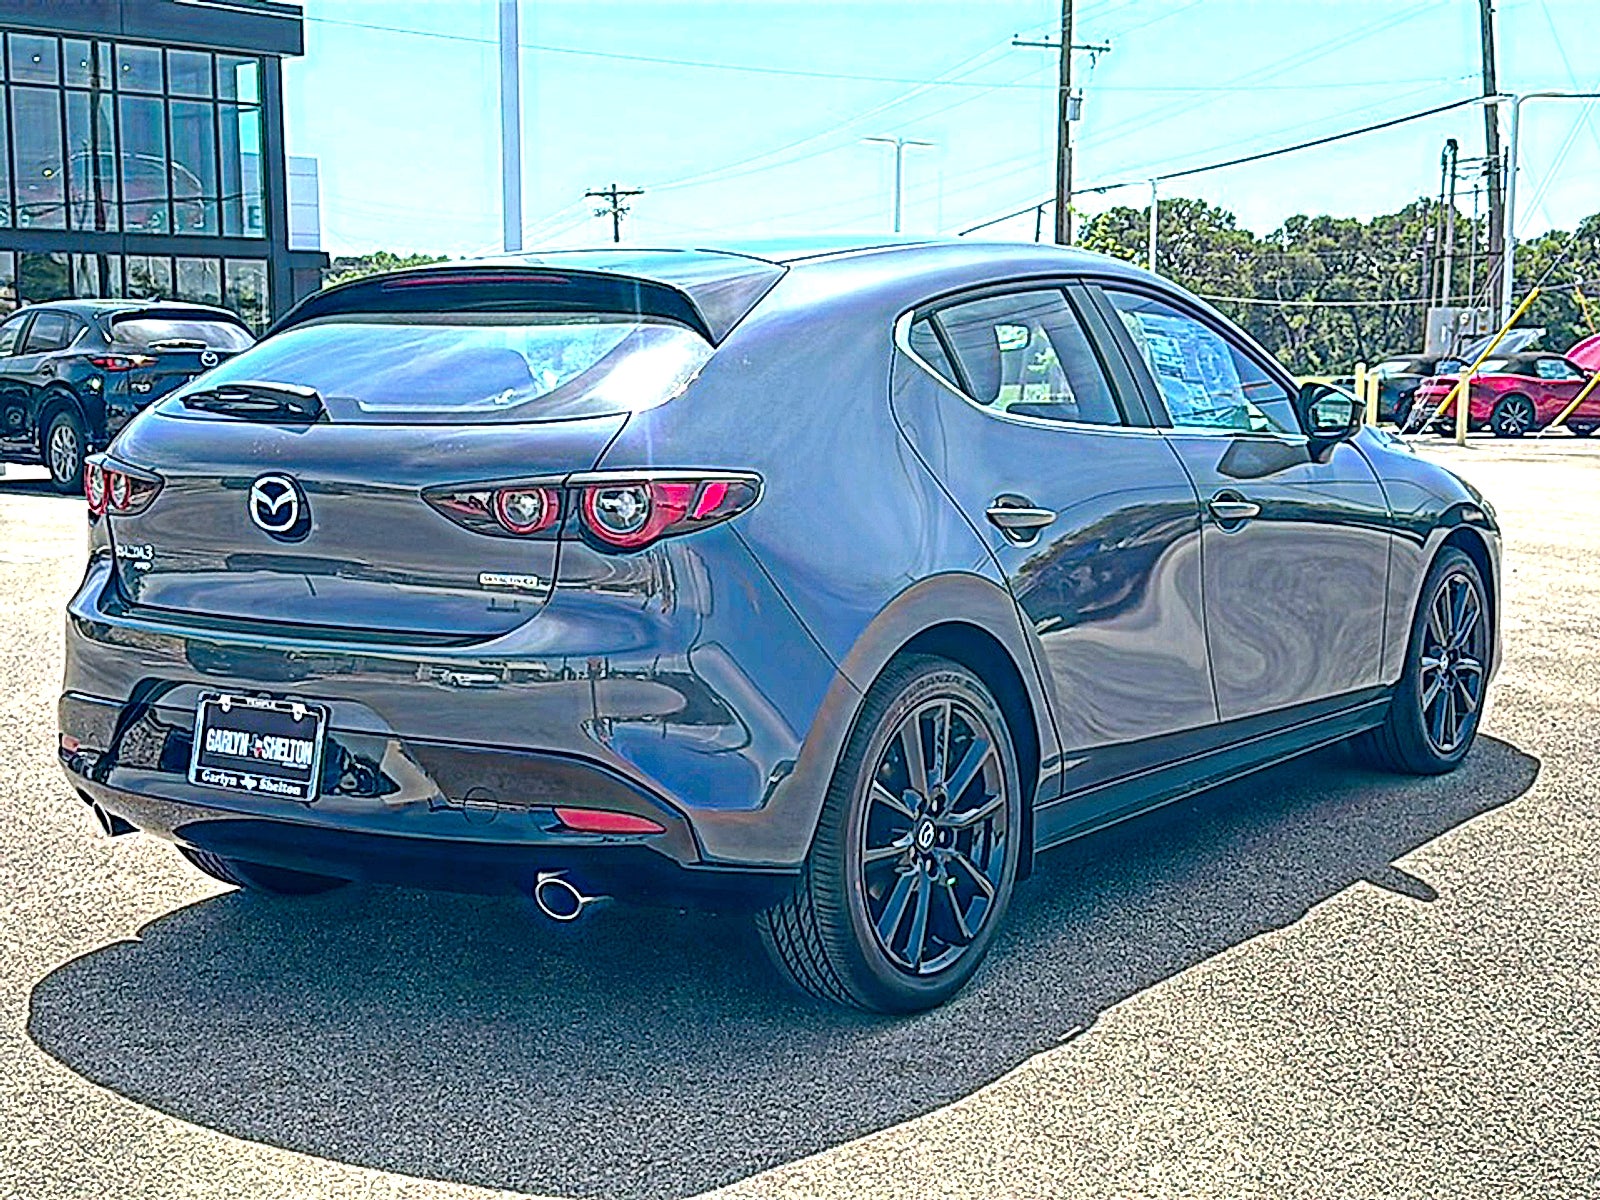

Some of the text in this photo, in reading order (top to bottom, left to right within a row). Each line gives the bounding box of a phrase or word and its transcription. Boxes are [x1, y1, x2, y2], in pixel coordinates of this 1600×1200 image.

[206, 728, 313, 764] GARLYN SHELTON
[201, 769, 302, 796] Garlyn Shelton
